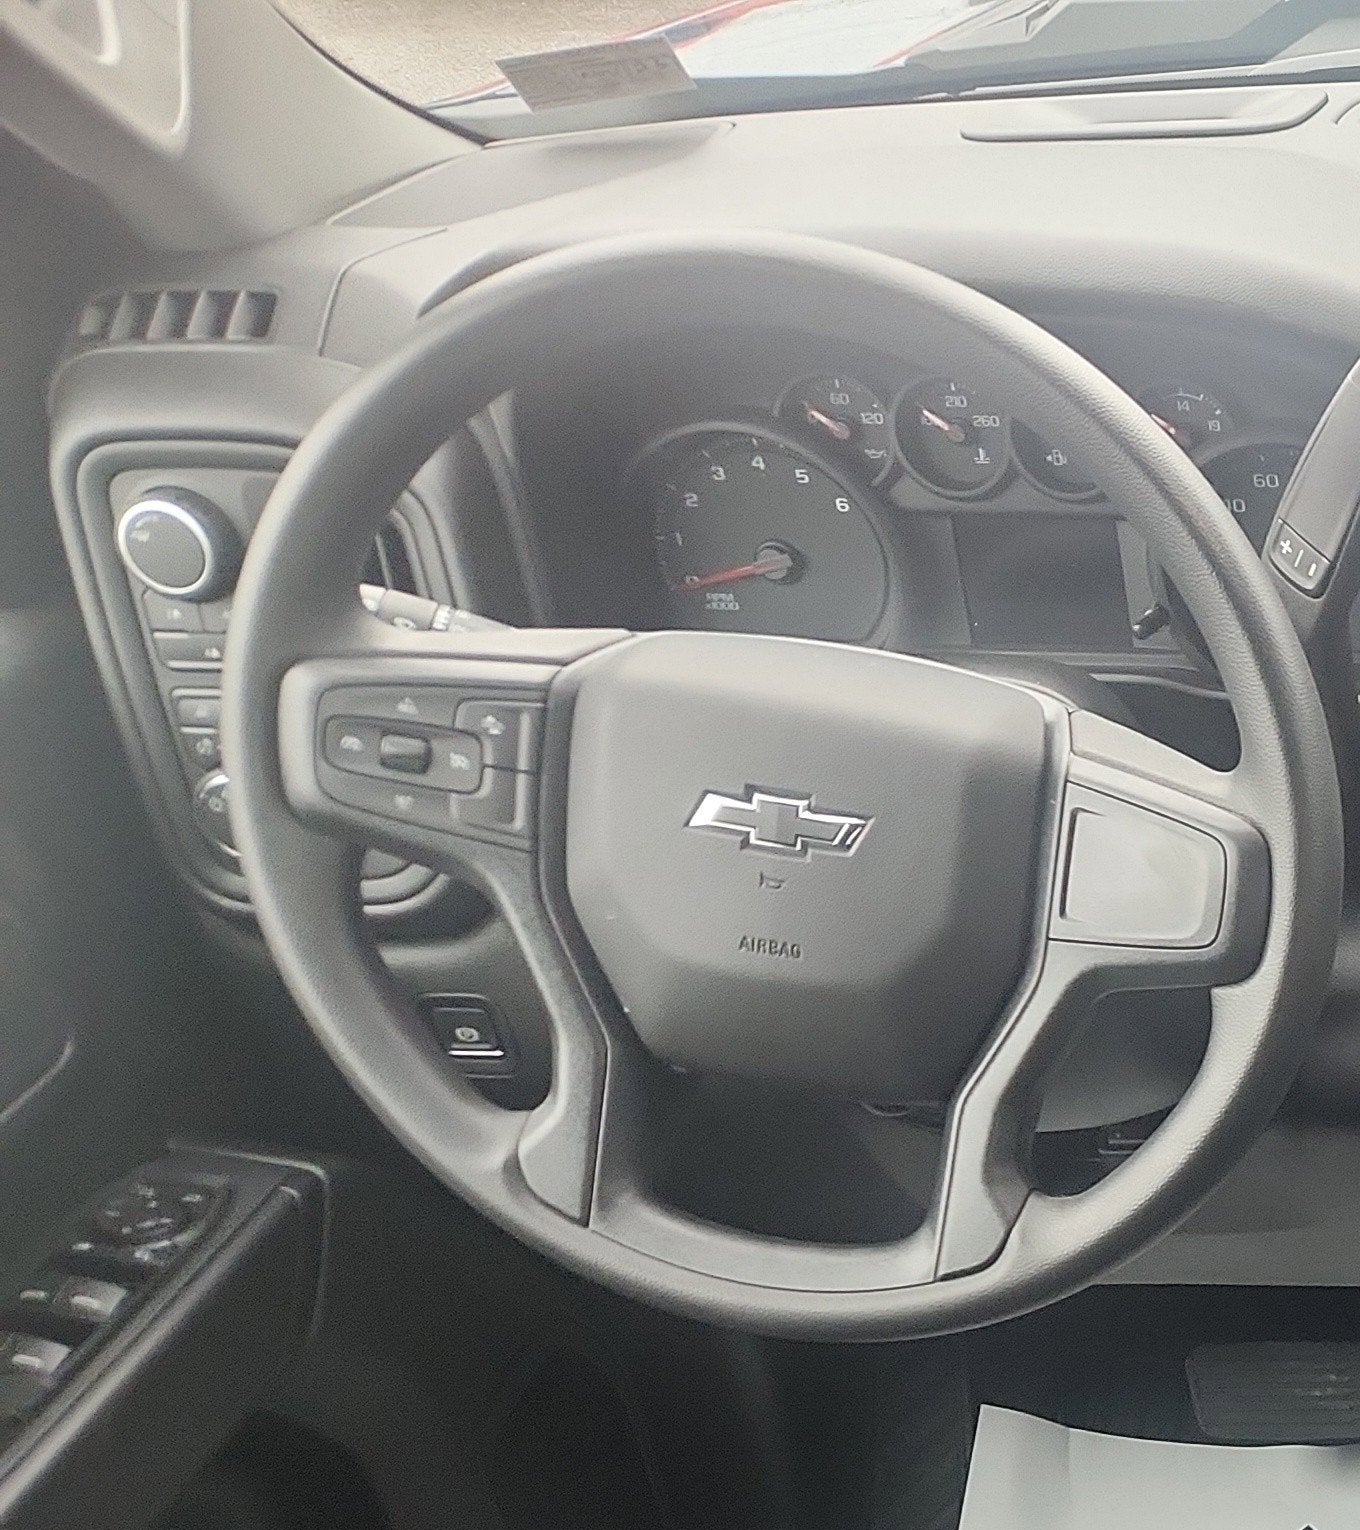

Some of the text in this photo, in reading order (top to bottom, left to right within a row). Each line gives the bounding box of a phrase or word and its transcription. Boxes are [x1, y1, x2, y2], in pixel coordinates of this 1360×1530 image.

[1177, 400, 1190, 411] 14
[973, 414, 1000, 427] 260
[1208, 420, 1221, 432] 19
[752, 455, 765, 470] 4
[711, 465, 726, 481] 3
[794, 469, 810, 484] 5
[1253, 474, 1279, 488] 60
[684, 492, 699, 507] 2
[835, 497, 850, 512] 6
[738, 935, 801, 959] AIRBAG
